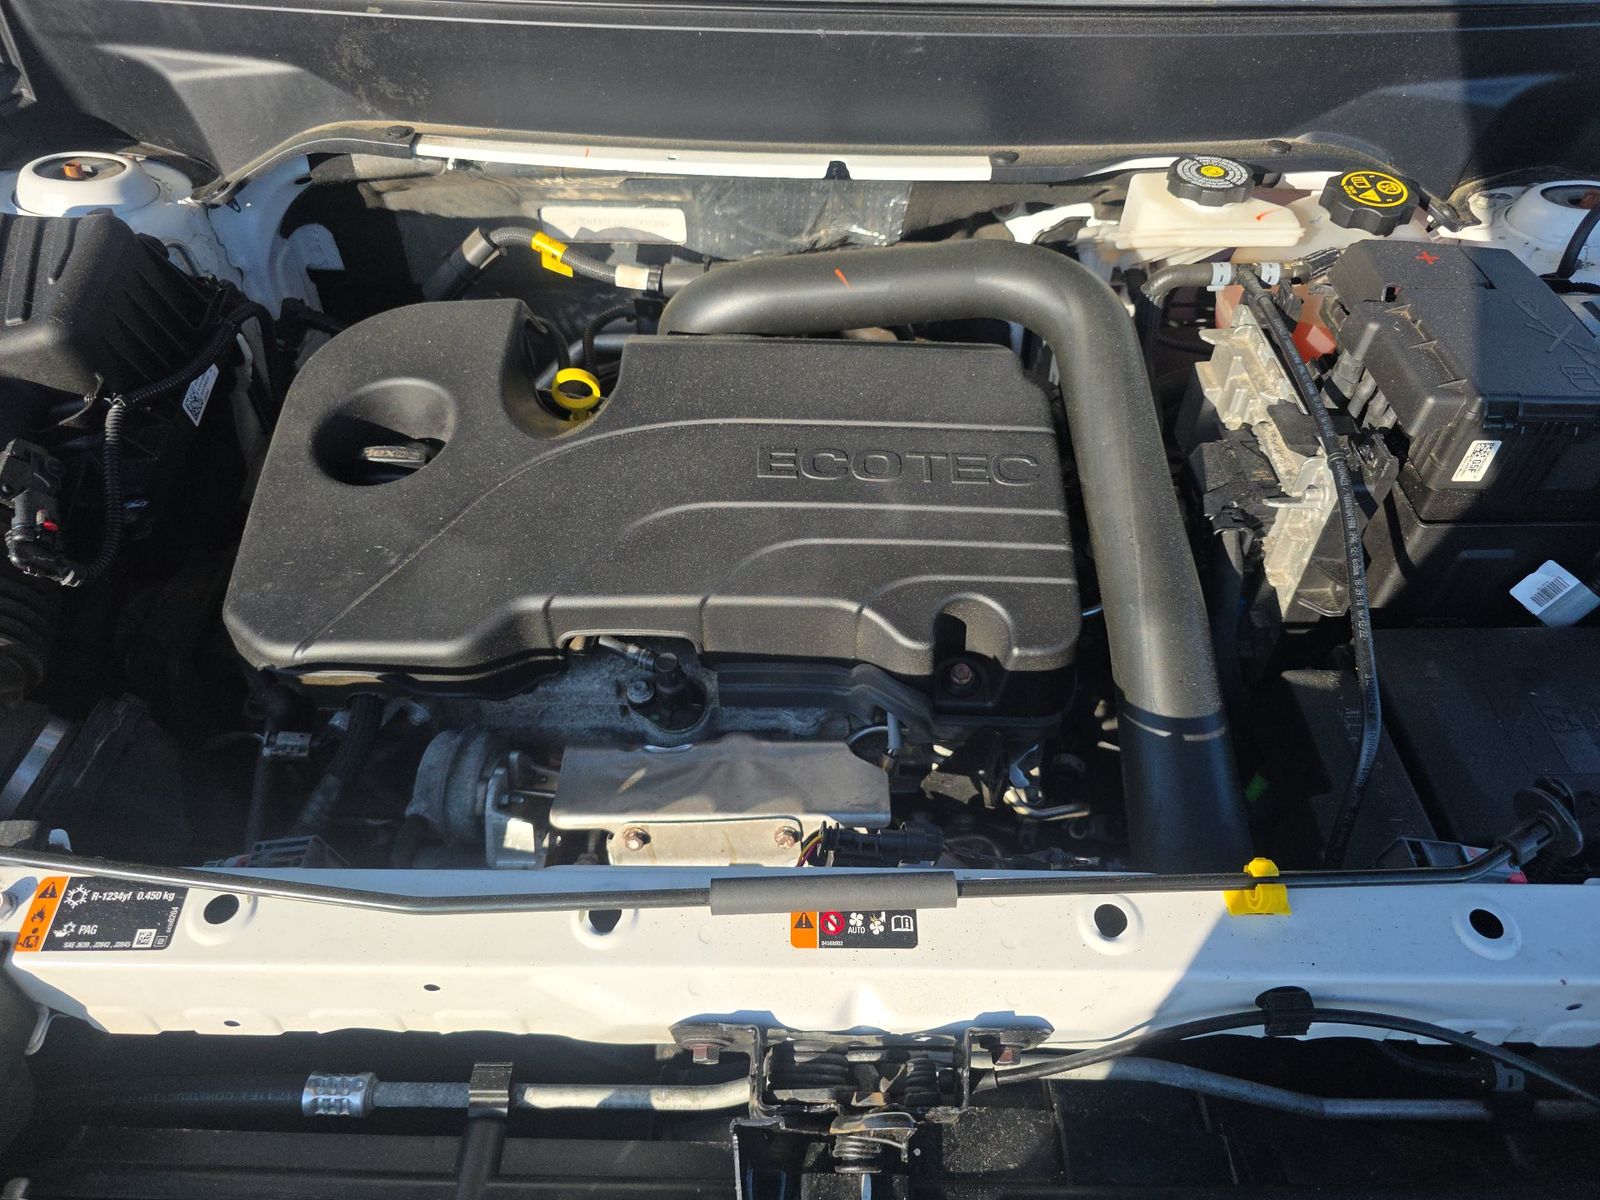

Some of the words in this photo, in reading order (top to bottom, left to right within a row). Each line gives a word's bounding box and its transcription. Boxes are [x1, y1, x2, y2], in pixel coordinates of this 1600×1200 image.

[757, 449, 1040, 486] ECOTEC
[91, 891, 131, 902] R-1234yf
[137, 891, 162, 900] 0.450
[163, 891, 175, 902] kg
[78, 925, 98, 935] PAG
[848, 926, 866, 934] AUTO
